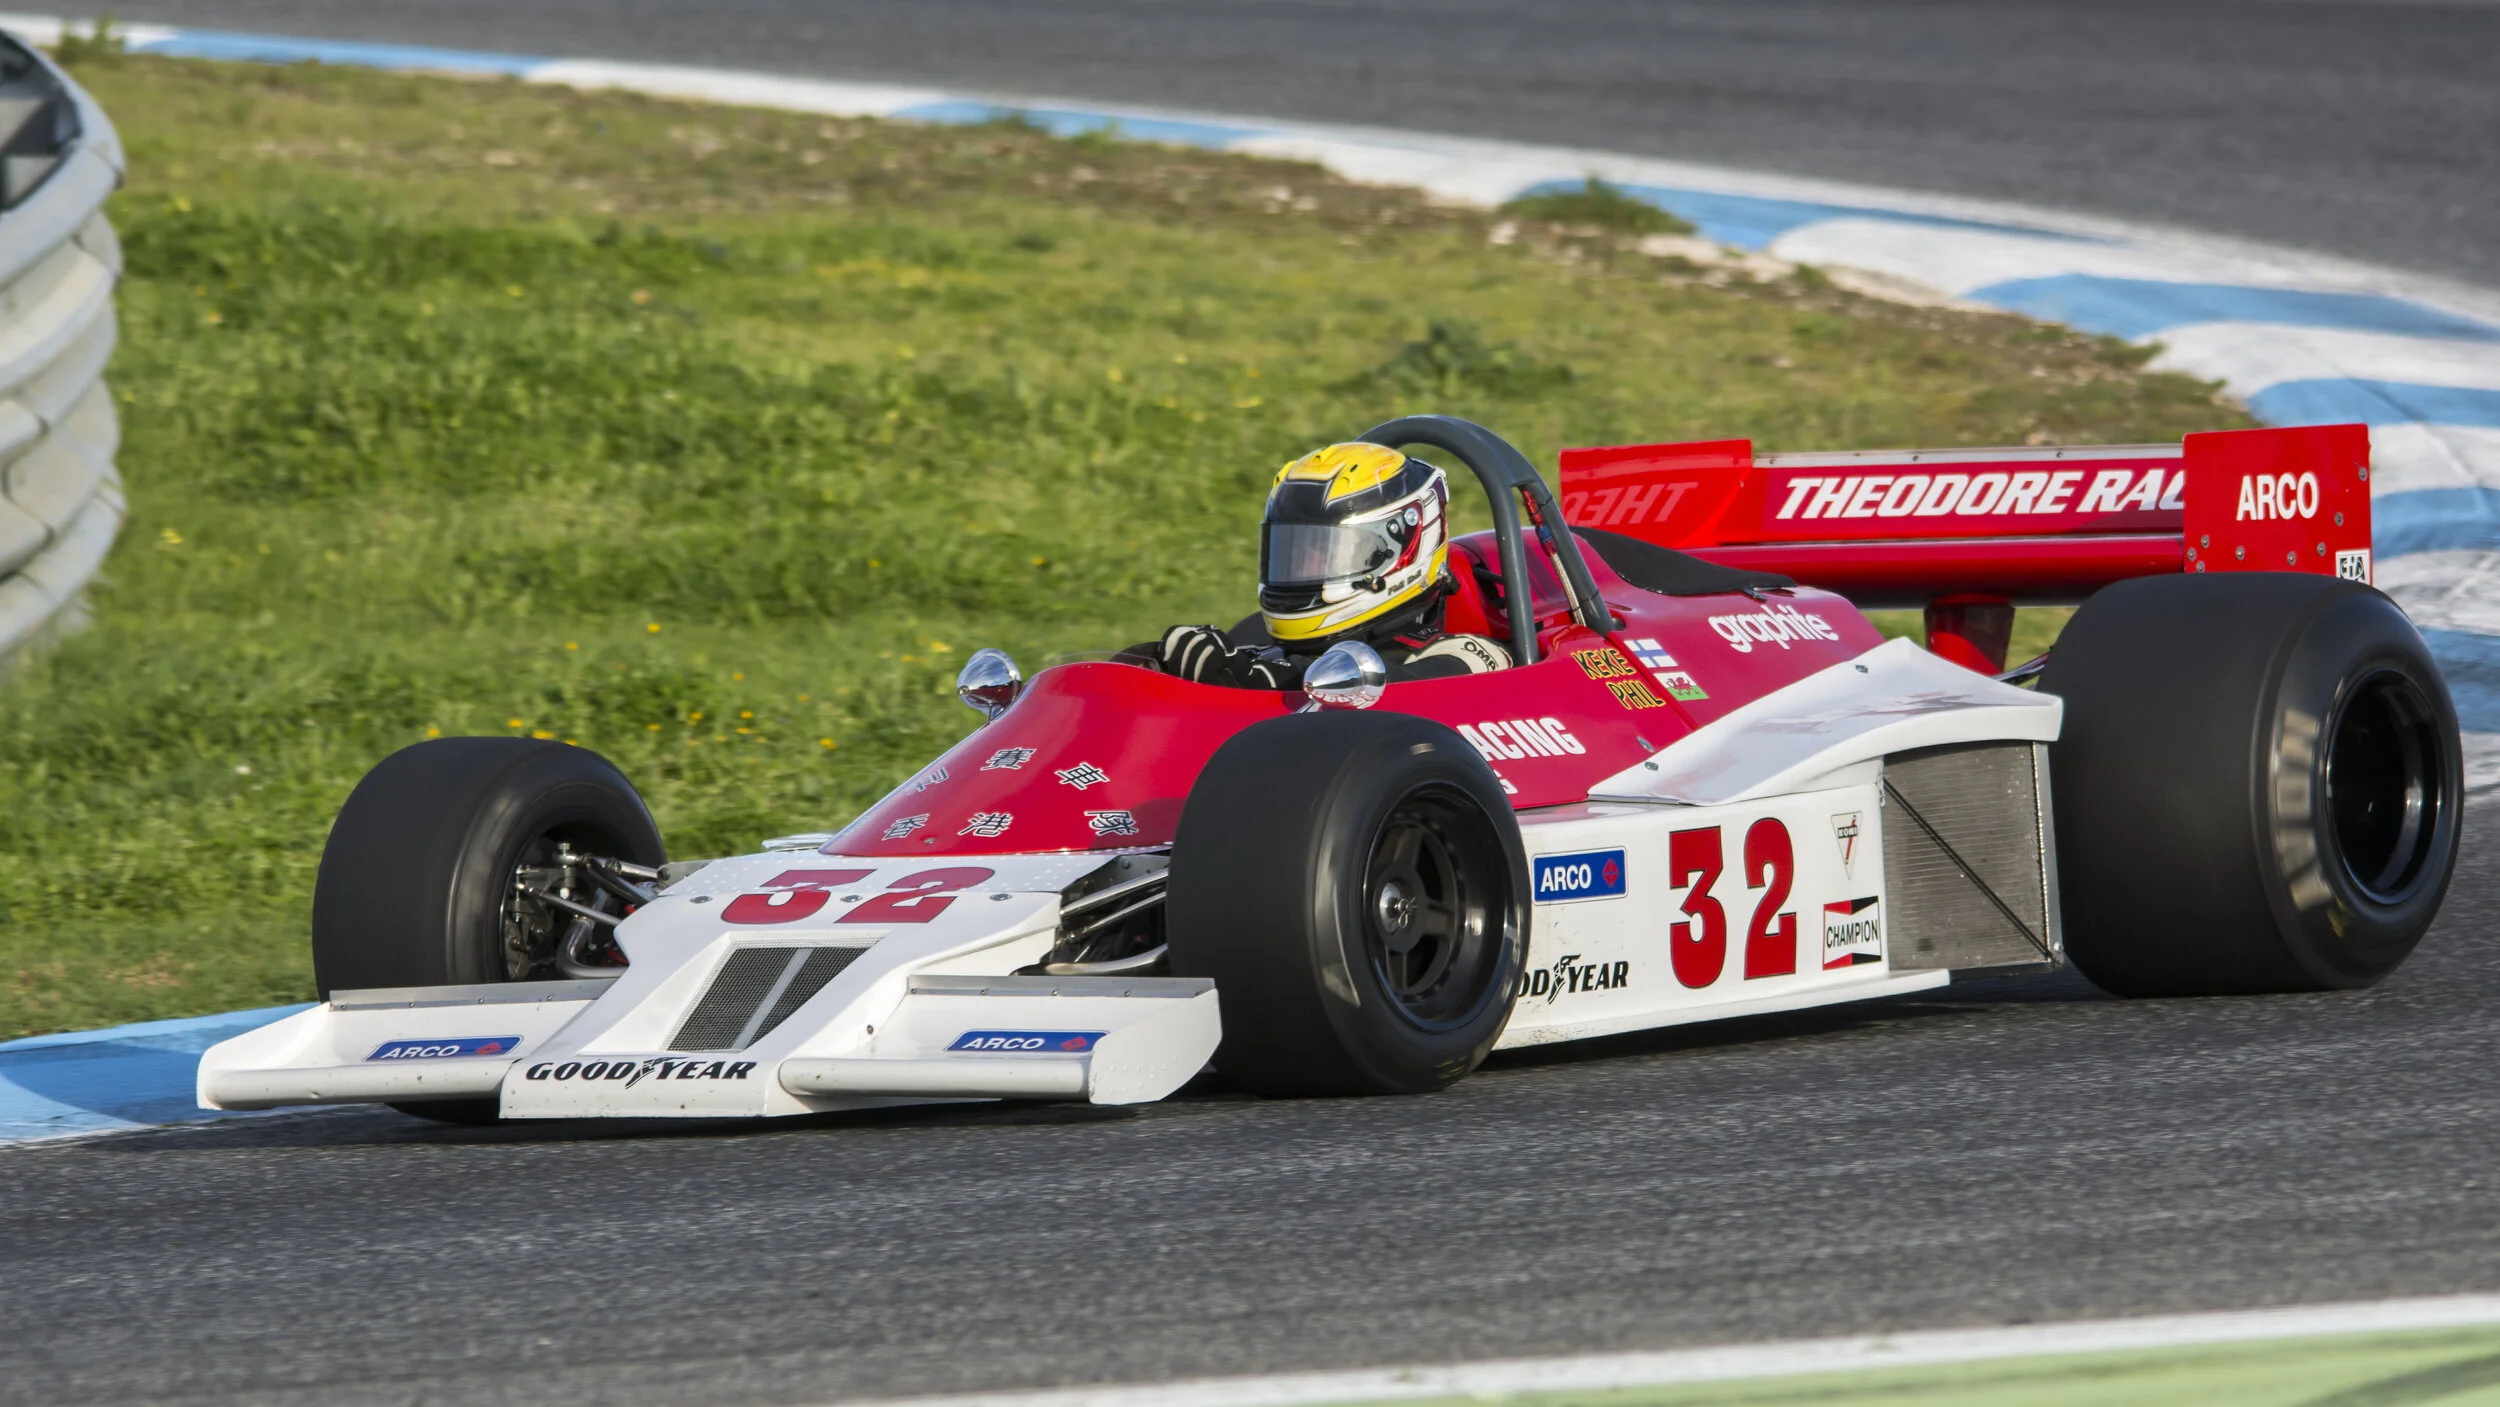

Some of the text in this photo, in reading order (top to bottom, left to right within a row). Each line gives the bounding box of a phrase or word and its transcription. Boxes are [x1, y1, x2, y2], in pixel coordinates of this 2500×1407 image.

[1775, 468, 2185, 520] THEODORE RAC
[2236, 471, 2320, 521] ARCO
[1708, 604, 1839, 653] graphite
[1570, 648, 1636, 680] KEKE
[1605, 680, 1666, 710] PHIL
[1456, 717, 1587, 762] ACING
[1838, 826, 1858, 838] KONI
[1540, 863, 1592, 892] ARCO
[720, 867, 995, 924] 32
[1669, 817, 1797, 989] 32
[1826, 919, 1879, 949] CHAMPION
[380, 1045, 461, 1059] ARCO
[962, 1037, 1046, 1050] ARCO
